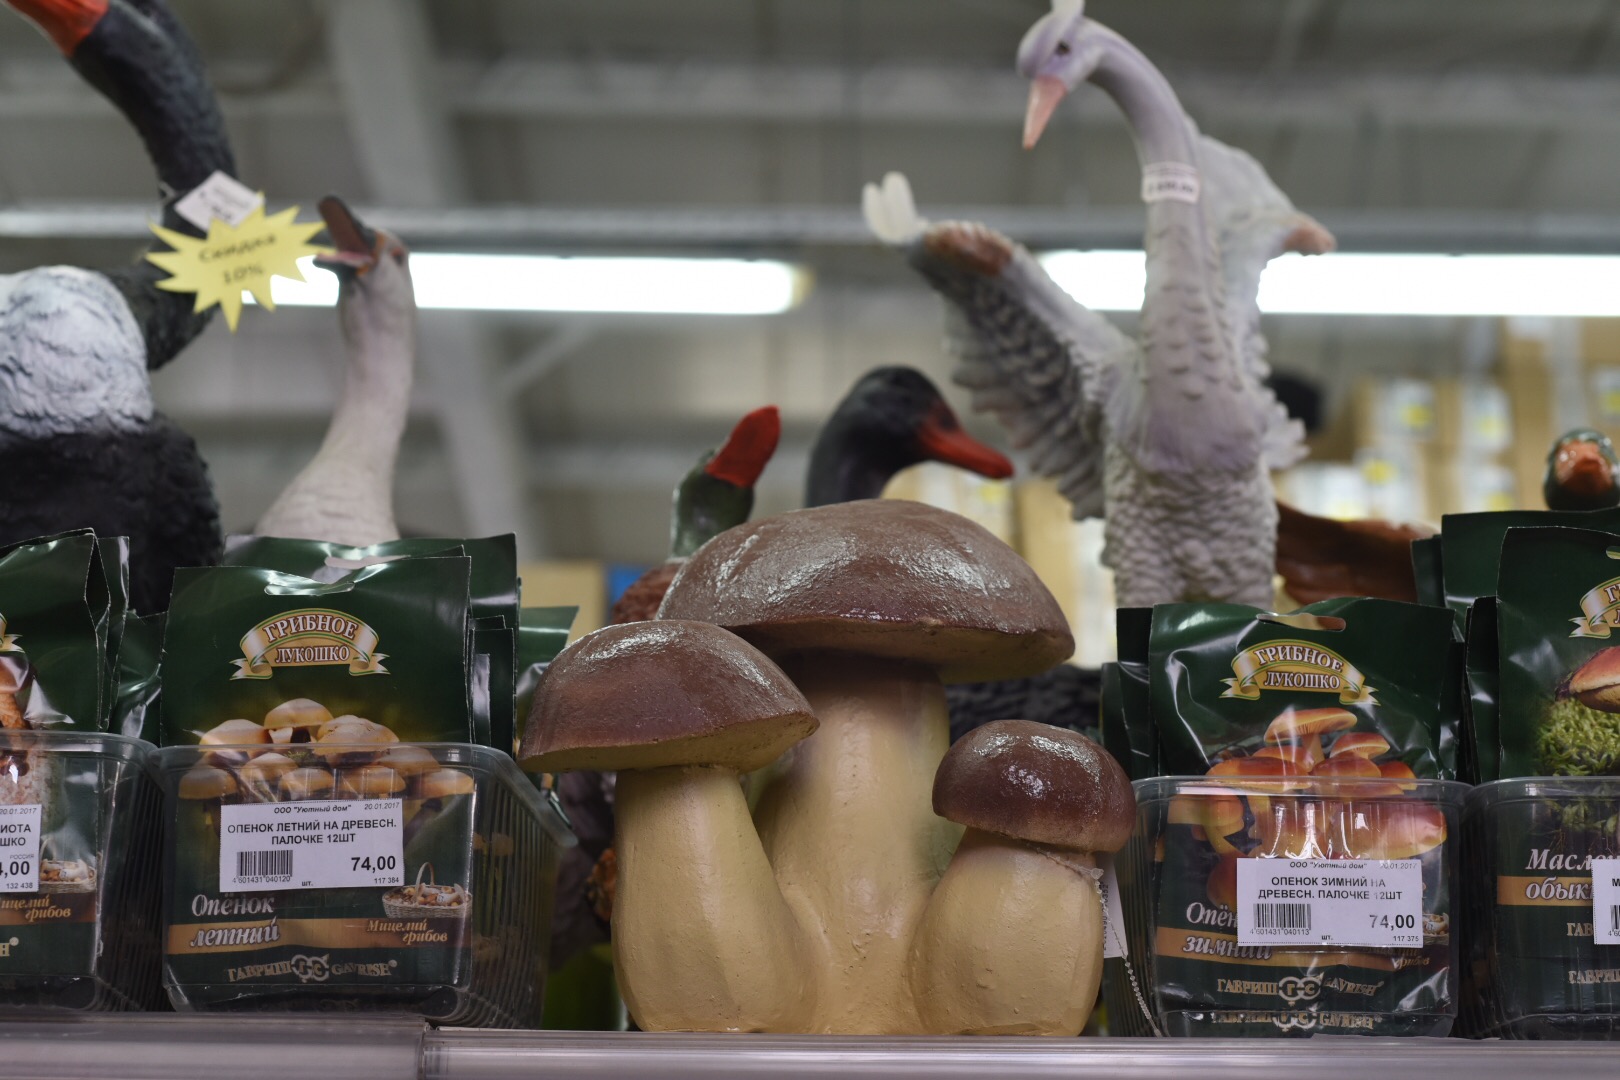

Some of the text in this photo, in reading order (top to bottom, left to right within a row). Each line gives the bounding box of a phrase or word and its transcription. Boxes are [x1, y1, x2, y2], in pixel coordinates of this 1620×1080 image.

[200, 234, 275, 262] Скидка
[224, 265, 264, 284] 10%
[263, 614, 358, 642] ГРИБНОЕ
[275, 645, 350, 663] ЛУКОШКО
[1254, 645, 1344, 673] ГРИБНОЕ
[1264, 671, 1340, 689] ЛУКОШКО
[273, 804, 352, 814] ООО "Уютный дом"
[364, 801, 400, 811] 20.01.2017
[227, 818, 397, 834] ОПЕНОК ЛЕТНИЙ НА ДРЕВЕСН.
[271, 833, 356, 845] ПАЛОЧКЕ 12ШТ
[351, 855, 396, 873] 74,00
[1348, 862, 1368, 870] дом"
[20, 881, 33, 889] 438
[374, 876, 399, 885] 117 384
[1271, 875, 1386, 888] ОПЕНОК ЗИМНИЙ НА
[1258, 889, 1403, 900] ДРЕВЕСН. ПАЛОЧКЕ 12ШТ
[191, 892, 275, 917] Опёнок
[25, 905, 72, 922] грибов
[1186, 902, 1237, 928] Опён
[1369, 913, 1415, 931] 74,00
[190, 916, 280, 947] летний
[366, 917, 428, 933] Мицелий
[402, 930, 448, 946] грибов
[228, 960, 292, 982] ГАВРИШ
[1217, 979, 1278, 996] ГАВРИШ
